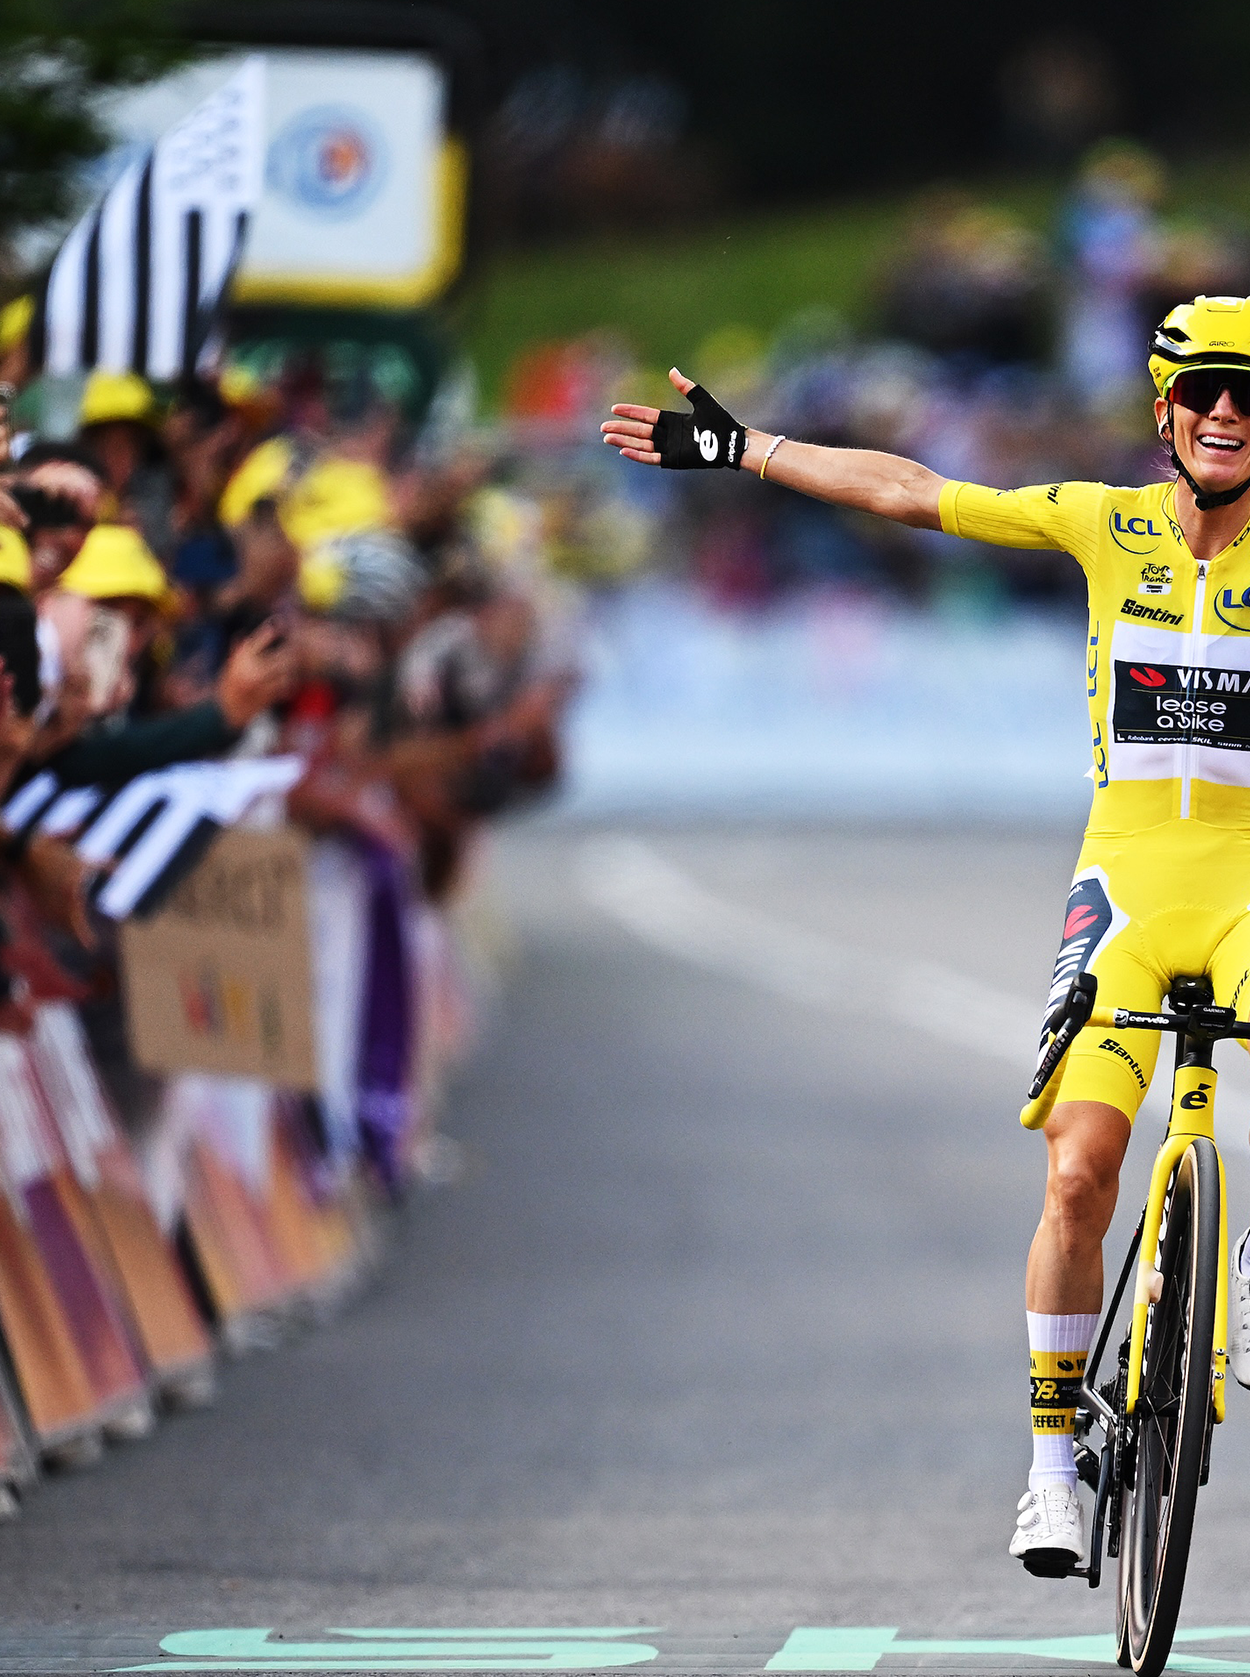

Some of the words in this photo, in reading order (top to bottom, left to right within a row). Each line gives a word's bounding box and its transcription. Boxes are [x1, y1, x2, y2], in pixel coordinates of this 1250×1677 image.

[1208, 340, 1235, 348] GIRO
[1114, 512, 1162, 536] LCL
[1120, 598, 1185, 626] Santini
[1156, 695, 1228, 715] lease
[1192, 737, 1212, 745] SKIL
[1094, 721, 1109, 789] LCL
[1129, 1016, 1170, 1025] cervélo
[1098, 1038, 1148, 1090] Santini
